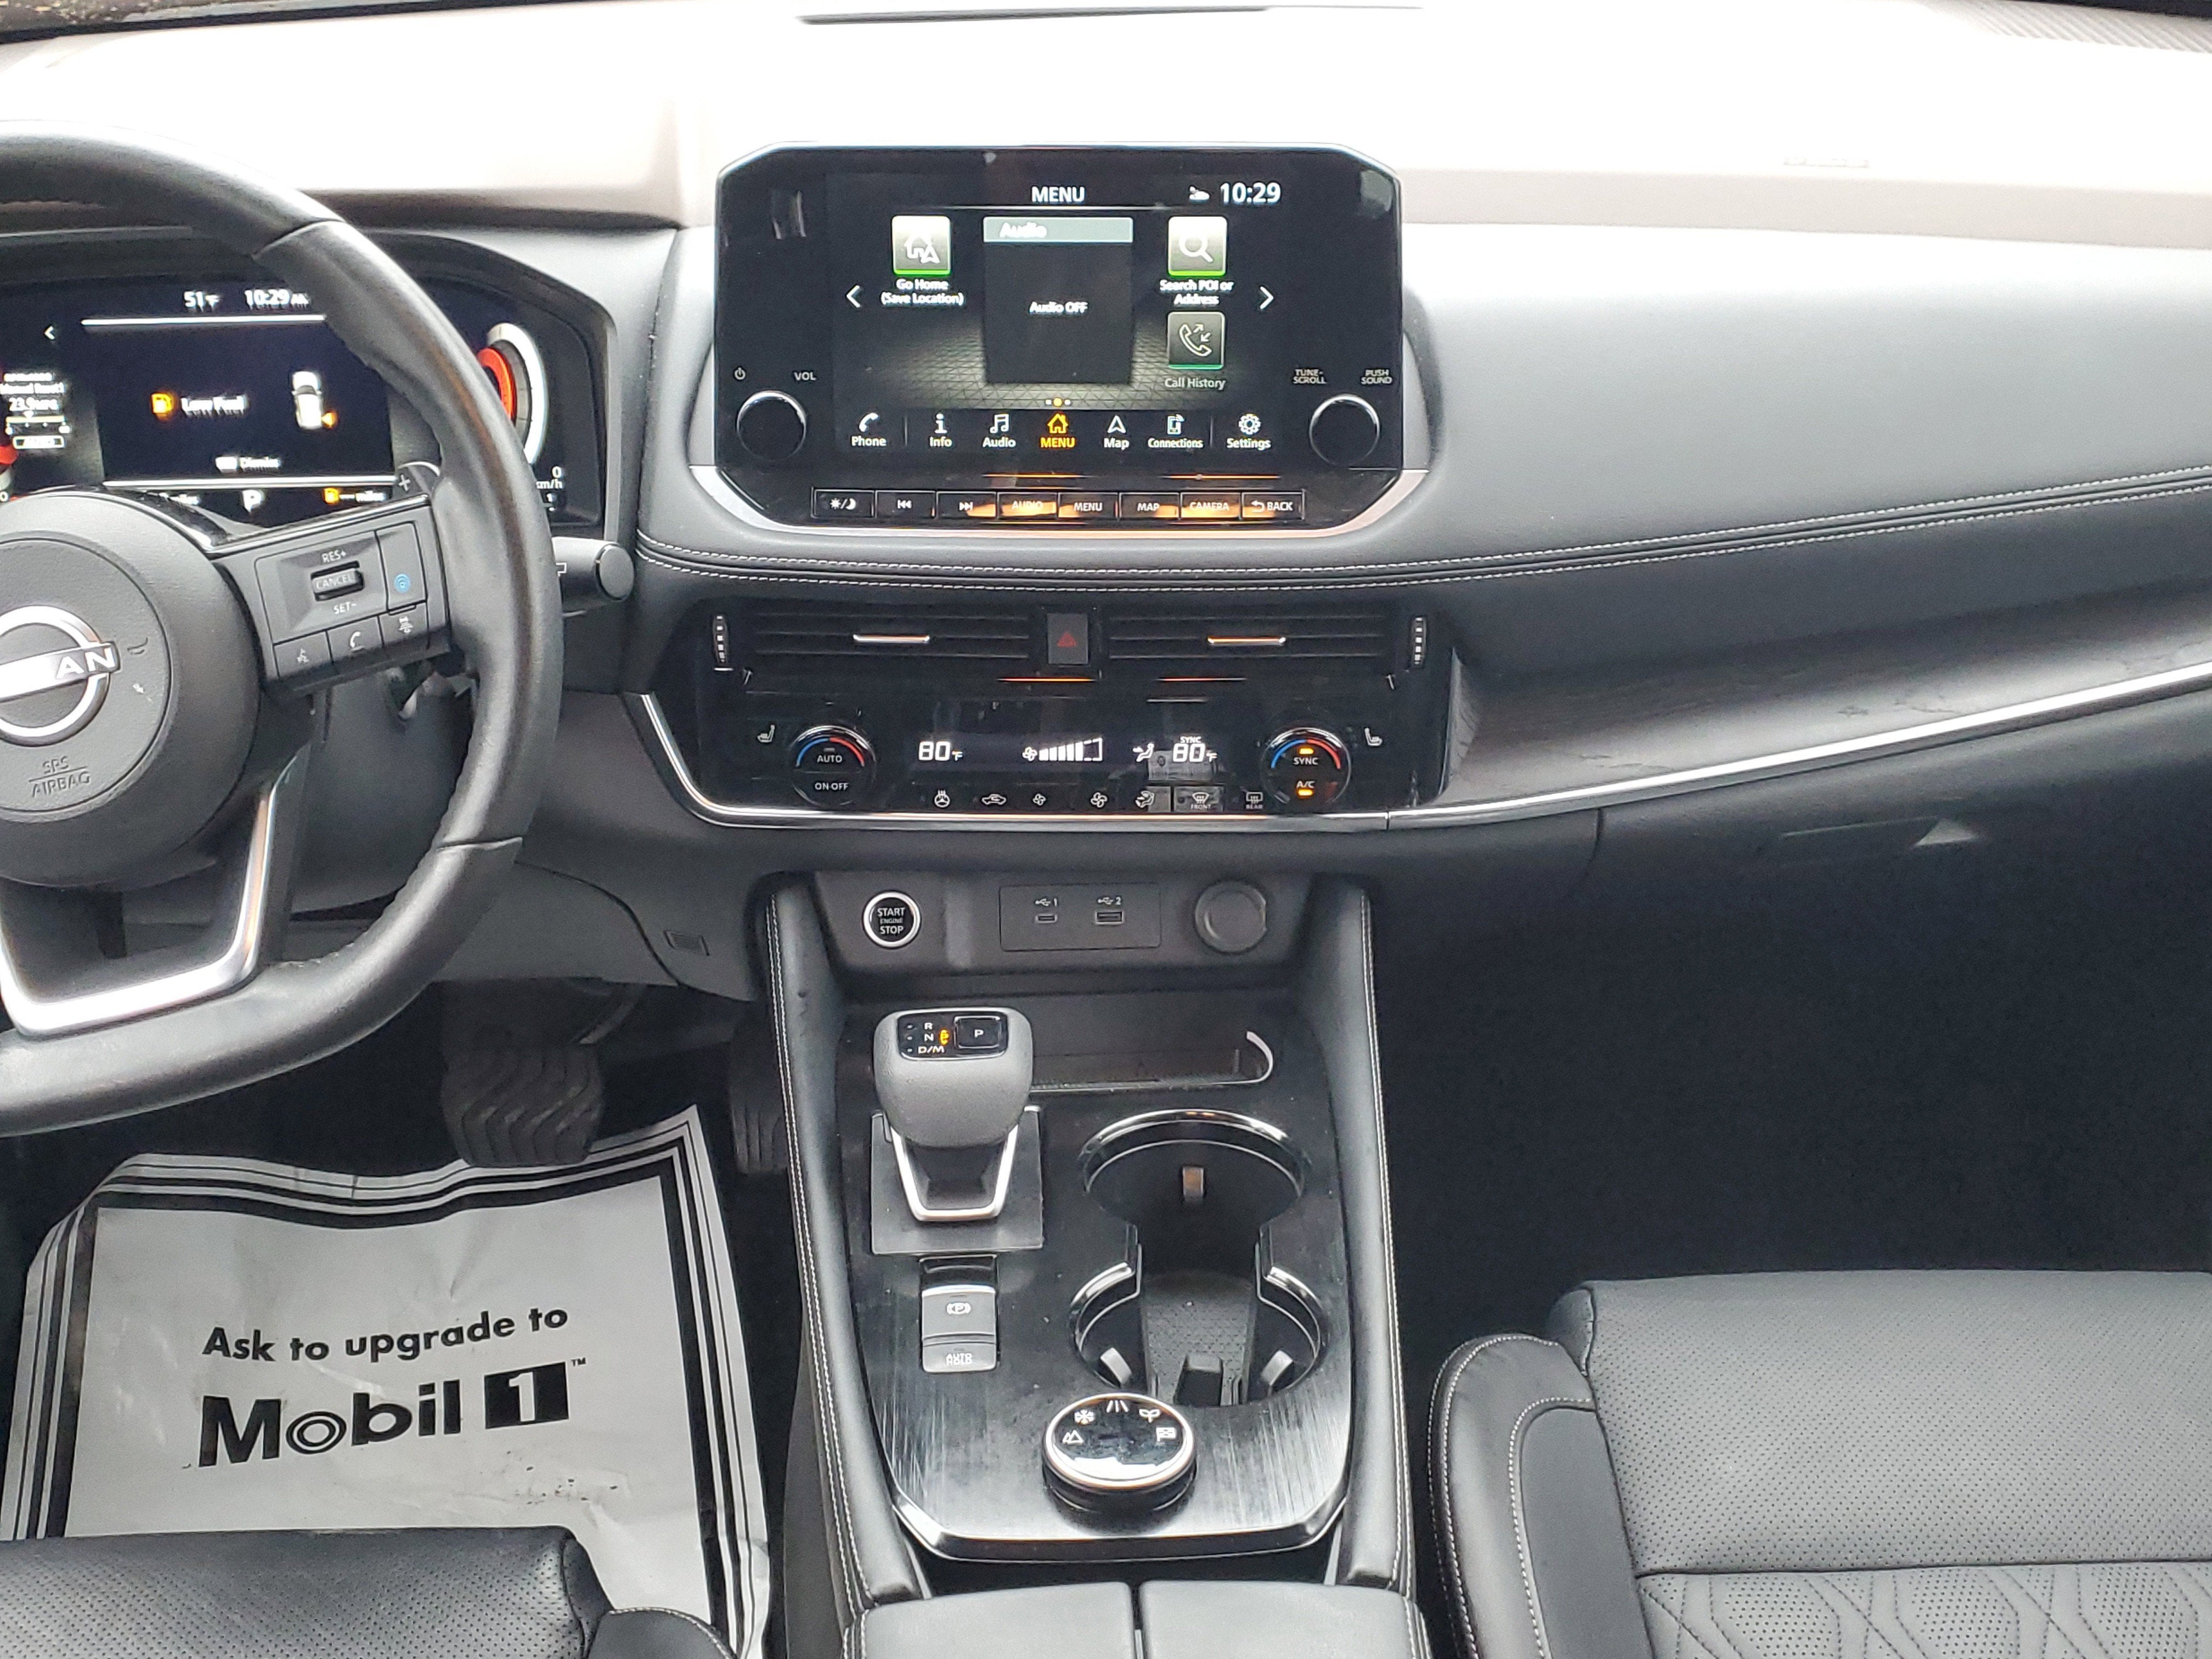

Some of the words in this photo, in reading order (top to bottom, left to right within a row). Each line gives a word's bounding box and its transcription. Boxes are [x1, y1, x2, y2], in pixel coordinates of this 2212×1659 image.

[1031, 187, 1085, 202] MENU
[1220, 183, 1282, 203] 10:29
[1000, 222, 1047, 239] Audio
[896, 279, 913, 290] Go
[915, 279, 949, 290] Home
[1160, 279, 1197, 291] Search
[1198, 280, 1218, 291] POI
[1220, 281, 1234, 291] or
[881, 292, 911, 305] (Save
[912, 292, 964, 306] Location)
[1030, 301, 1064, 313] Audio
[1065, 301, 1088, 313] OFF
[794, 371, 816, 381] VOL
[1365, 369, 1389, 377] PUSH
[1165, 377, 1183, 388] Call
[1186, 377, 1226, 391] History
[1361, 376, 1393, 385] SOUND
[851, 436, 887, 447] Phone
[930, 436, 952, 448] Info
[983, 437, 1016, 448] Audio
[1041, 438, 1075, 448] MENU
[1104, 438, 1130, 450] Map
[1148, 438, 1203, 449] Connections
[1227, 438, 1271, 451] Settings
[1012, 500, 1043, 509] AUDIO
[1074, 501, 1103, 511] MENU
[1137, 501, 1160, 511] MAP
[1189, 501, 1230, 511] CAMERA
[1267, 501, 1293, 511] BACK
[316, 574, 356, 589] CANCEL
[817, 755, 843, 763] AUTO
[1293, 757, 1318, 766] SYNC
[32, 771, 91, 798] AIRBAG
[1296, 780, 1315, 789] A/C
[877, 907, 906, 917] START
[880, 926, 904, 934] STOP
[924, 1022, 933, 1030] R
[924, 1033, 934, 1042] N
[974, 1029, 984, 1038] P
[918, 1046, 945, 1054] D/M
[202, 1327, 276, 1362] Ask
[290, 1338, 329, 1361] to
[346, 1311, 515, 1363] upgrade
[528, 1307, 568, 1332] to
[199, 1379, 461, 1468] Mobil
